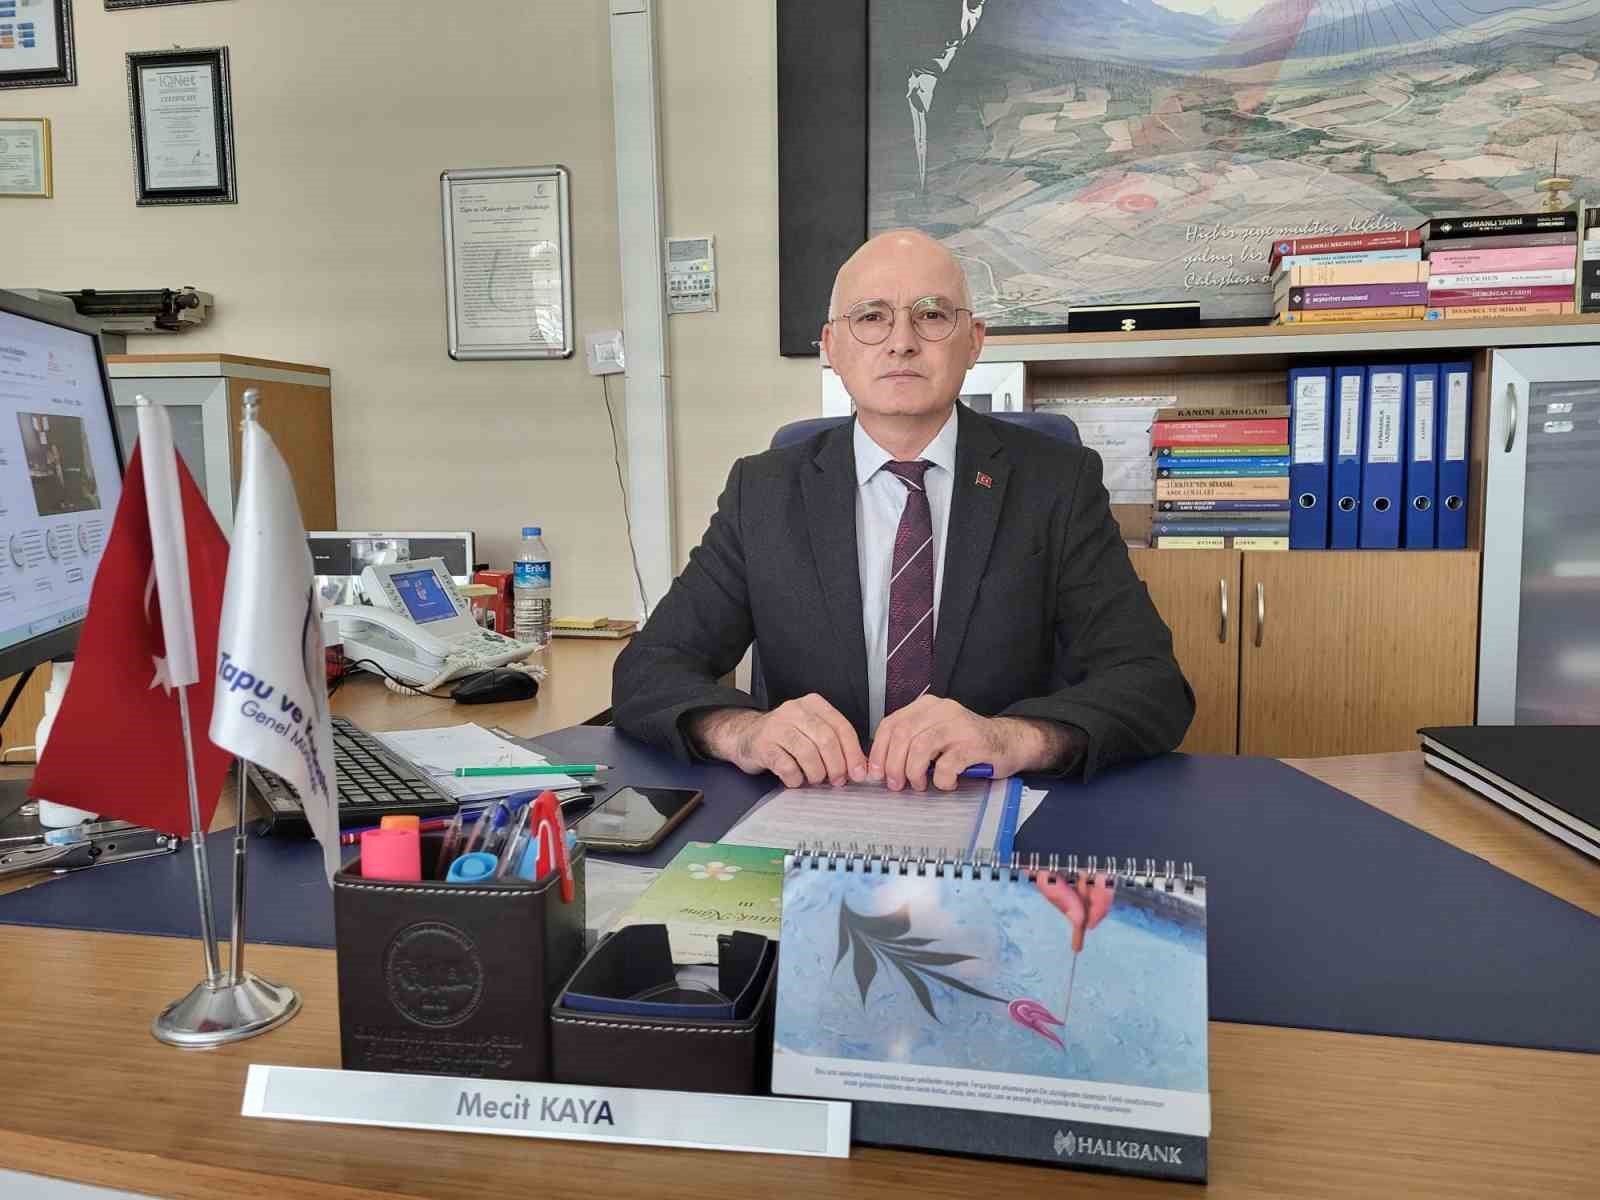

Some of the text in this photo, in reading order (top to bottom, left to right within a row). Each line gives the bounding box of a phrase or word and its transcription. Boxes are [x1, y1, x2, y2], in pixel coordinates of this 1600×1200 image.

[1462, 219, 1497, 229] OSMANLI
[1178, 407, 1215, 417] KANUNİ
[218, 651, 304, 723] Tapu ve
[240, 700, 292, 737] Genel
[456, 1091, 615, 1126] Mecit KAYA
[1077, 1135, 1184, 1167] HALKBANK
